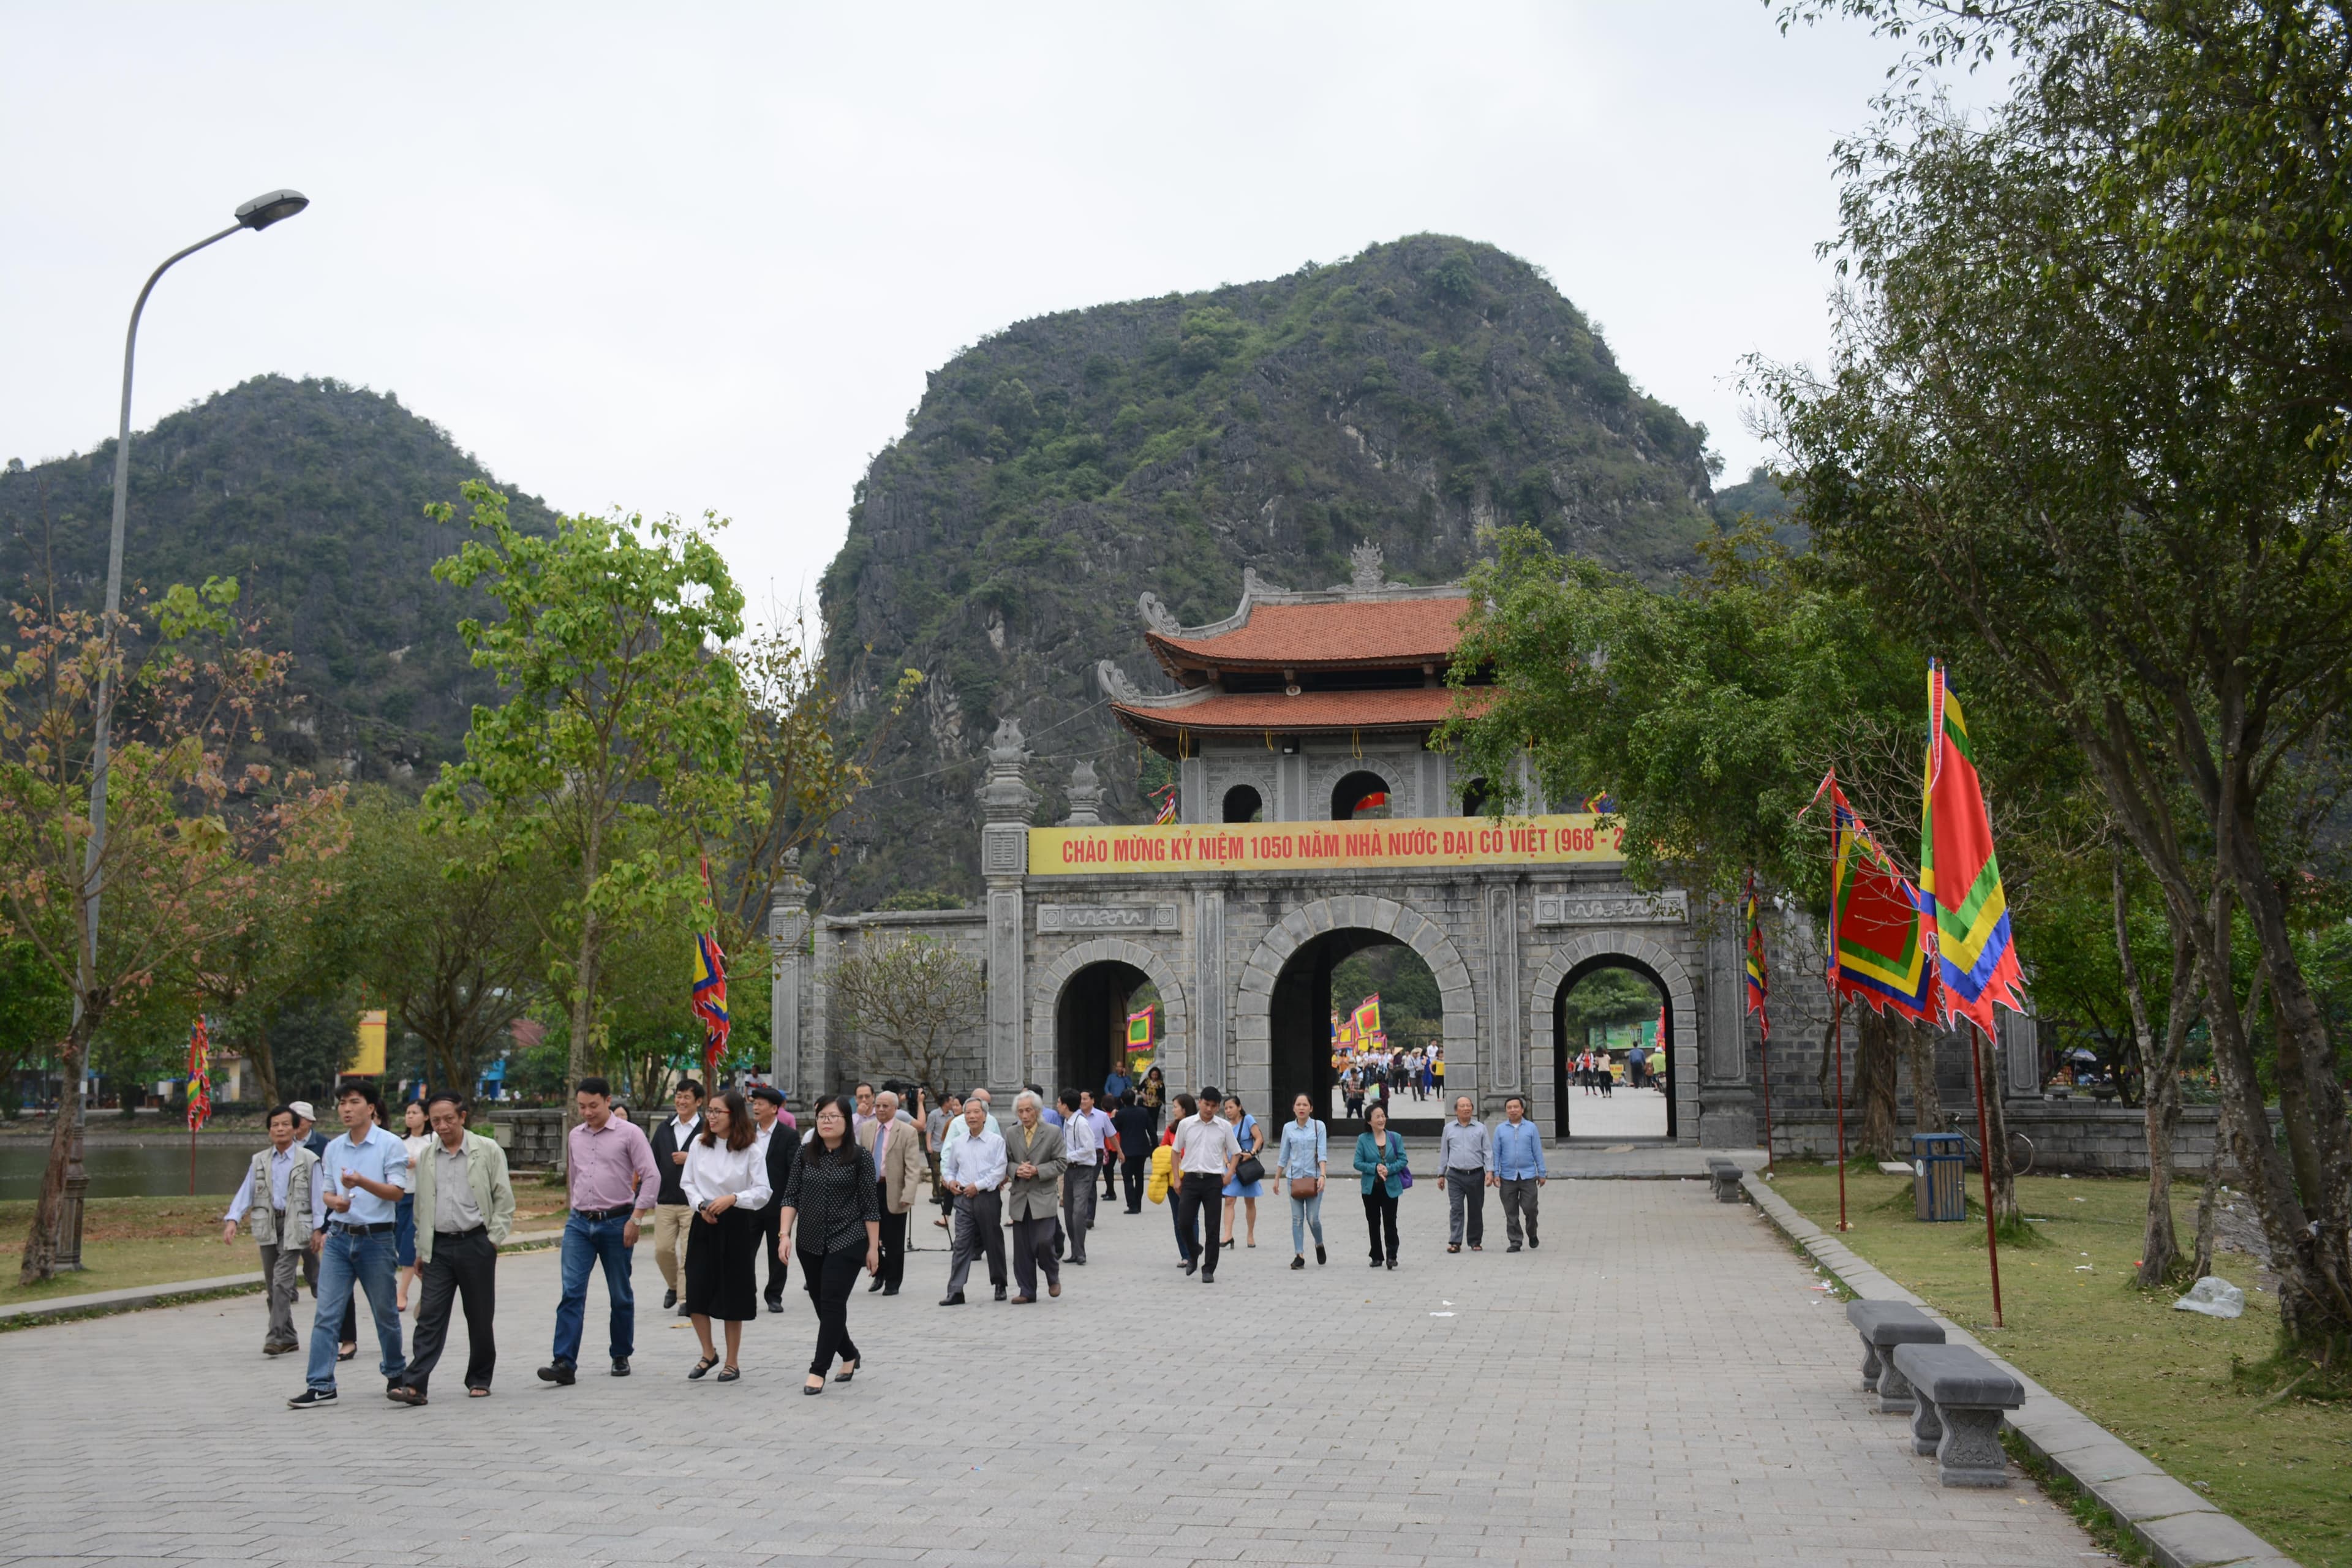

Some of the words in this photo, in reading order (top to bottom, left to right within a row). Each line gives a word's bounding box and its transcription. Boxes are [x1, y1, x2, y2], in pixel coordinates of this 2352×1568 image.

[1063, 835, 1108, 863] CHÀO
[1114, 834, 1166, 862] MỪNG
[1171, 830, 1193, 861] KỶ
[1199, 832, 1244, 865] NIỆM
[1251, 835, 1293, 859] 1050
[1298, 829, 1340, 858] NĂM
[1345, 829, 1383, 858] NHÀ
[1388, 827, 1438, 856] NƯỚC
[1443, 831, 1474, 859] ĐẠI
[1509, 824, 1548, 858] VIỆT
[1555, 827, 1595, 854] (968
